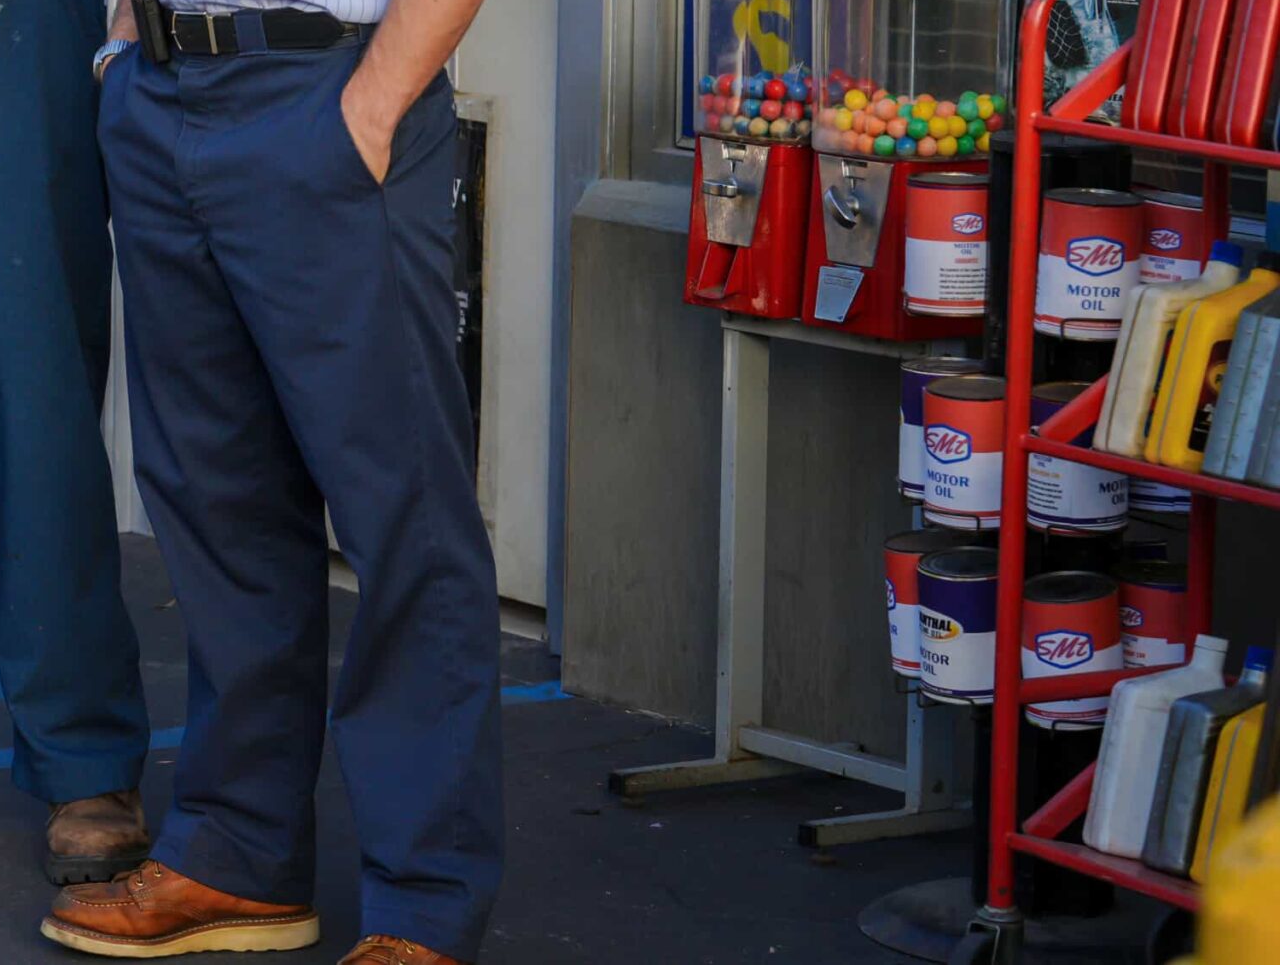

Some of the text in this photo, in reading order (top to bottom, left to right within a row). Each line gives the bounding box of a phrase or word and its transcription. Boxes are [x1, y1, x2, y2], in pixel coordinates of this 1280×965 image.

[1068, 285, 1120, 298] MOTOR
[1081, 299, 1105, 311] OIL
[927, 468, 969, 487] MOTOR
[935, 485, 955, 499] OIL
[923, 661, 937, 675] OIL
